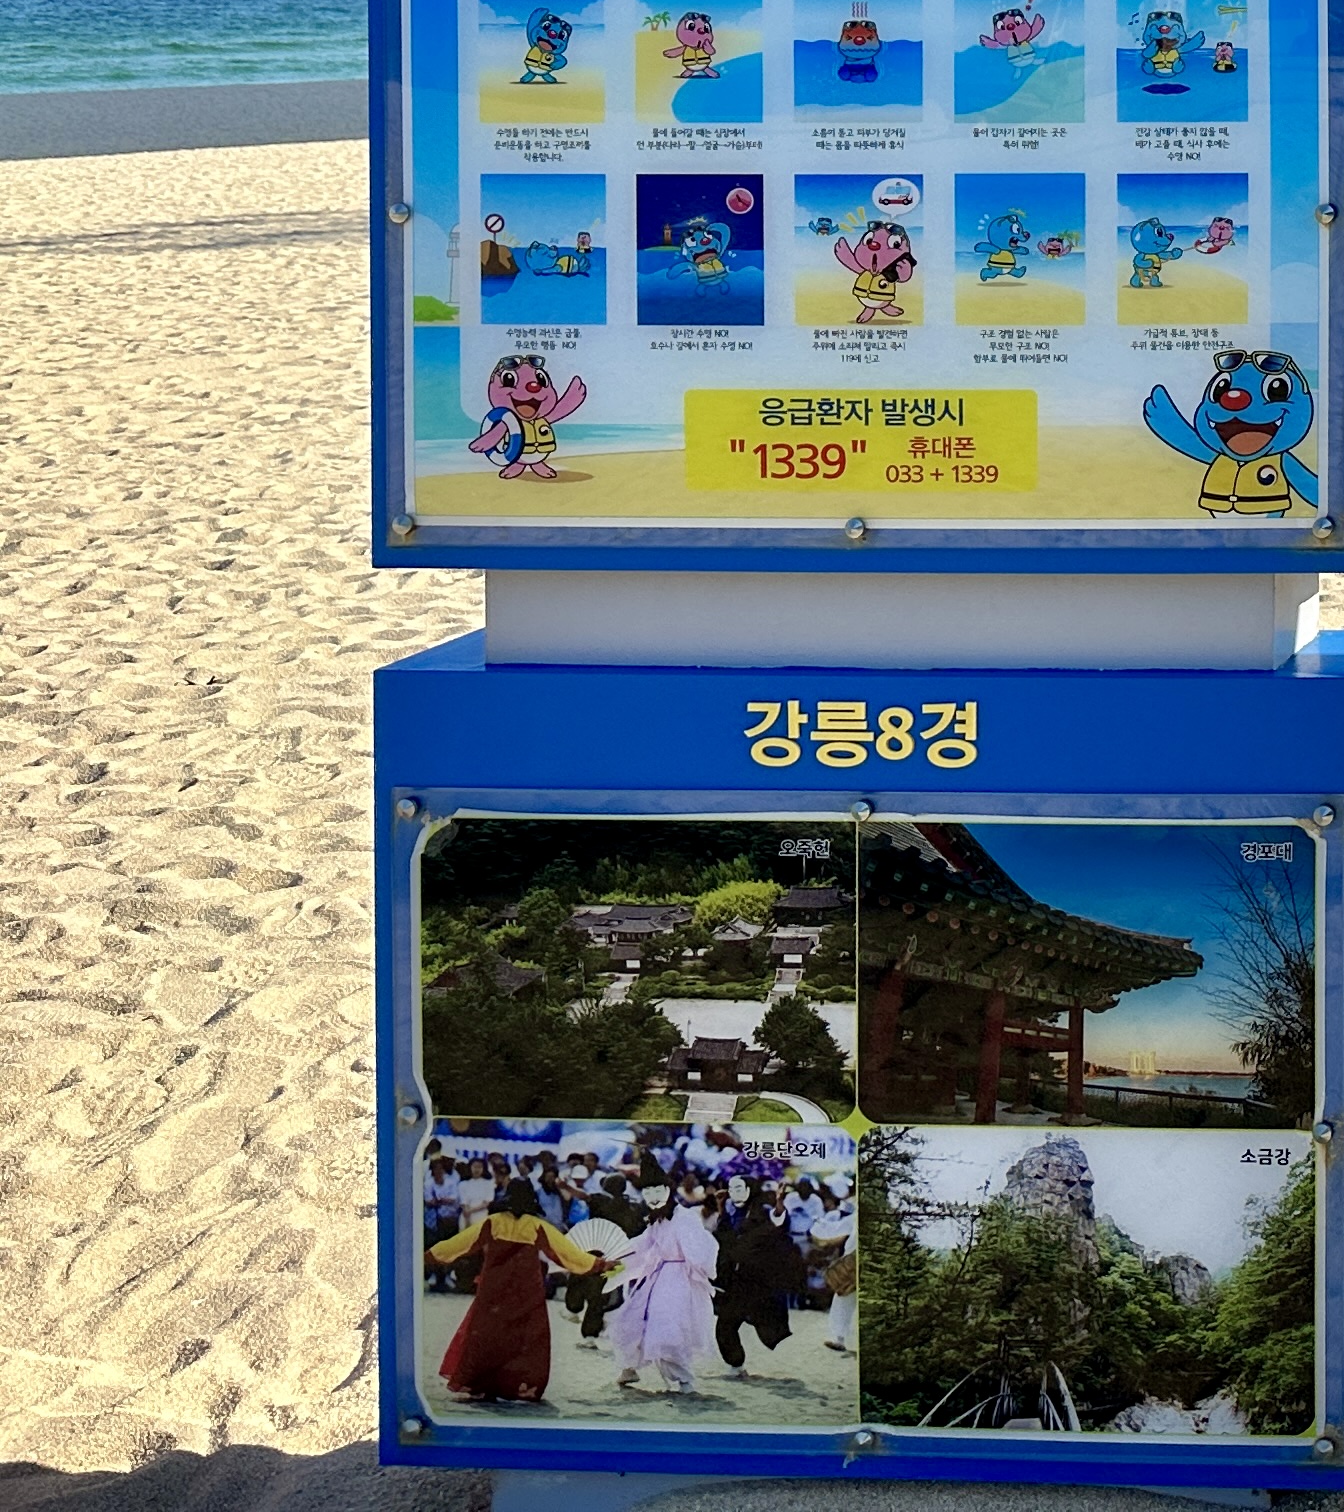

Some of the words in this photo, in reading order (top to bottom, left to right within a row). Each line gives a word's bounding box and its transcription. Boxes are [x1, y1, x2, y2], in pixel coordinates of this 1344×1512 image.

[758, 397, 873, 426] 응급환자
[881, 397, 964, 427] 발생시
[907, 436, 976, 460] 휴대폰
[729, 439, 867, 480] "1339"
[885, 464, 924, 483] 033
[952, 464, 999, 483] 1339
[743, 698, 979, 770] 강릉8경
[778, 838, 830, 859] 오죽헌
[1240, 842, 1293, 863] 경포대
[743, 1140, 827, 1161] 강릉단오제
[1240, 1148, 1291, 1166] 소금강
